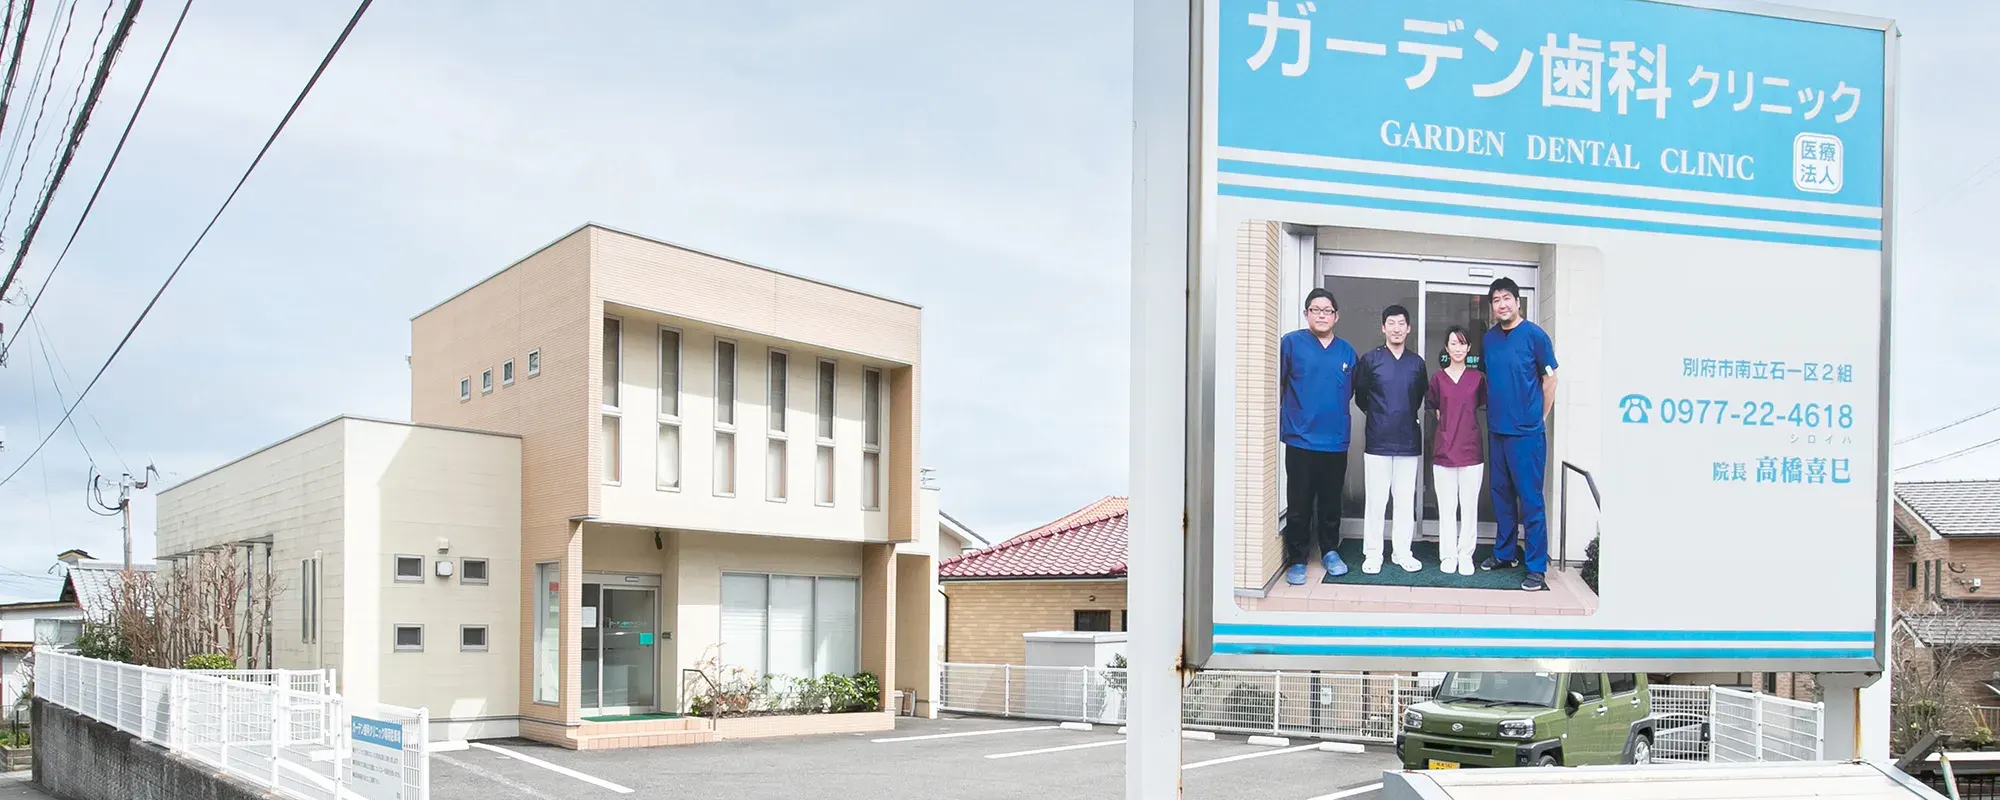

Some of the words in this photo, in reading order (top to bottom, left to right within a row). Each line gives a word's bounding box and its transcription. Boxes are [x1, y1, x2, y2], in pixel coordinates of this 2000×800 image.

[1246, 1, 1672, 119] ガーデン歯科
[1688, 64, 1862, 123] クリニック
[1380, 119, 1506, 157] GARDEN
[1527, 134, 1641, 170] DENTAL
[1660, 147, 1755, 181] CLINIC
[1801, 140, 1836, 161] 医療
[1801, 164, 1836, 185] 法人
[1660, 397, 1854, 429] 0977-22-4618
[1712, 461, 1748, 482] 院長
